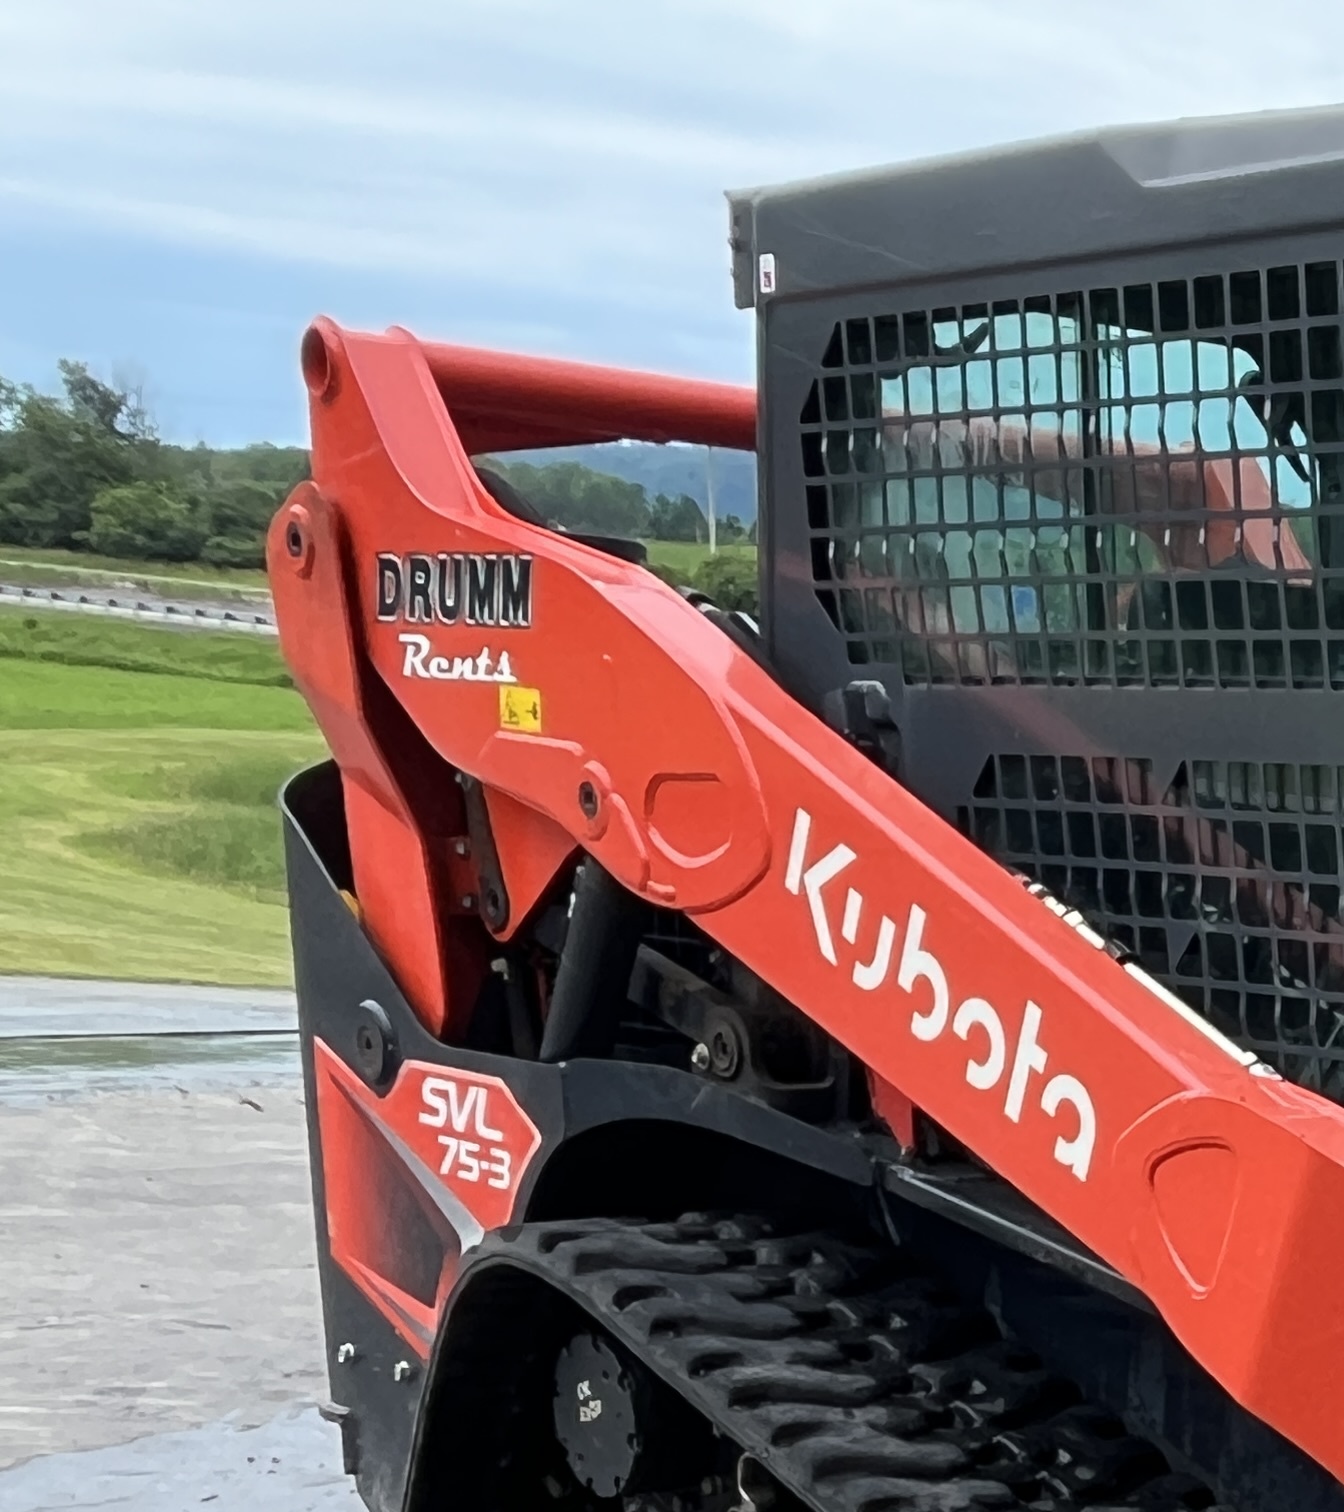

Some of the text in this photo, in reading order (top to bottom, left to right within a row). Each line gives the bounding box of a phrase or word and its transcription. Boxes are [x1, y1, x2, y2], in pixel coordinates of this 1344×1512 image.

[376, 552, 534, 629] DRUMM
[398, 632, 518, 683] Rents
[785, 807, 1097, 1182] Kubota
[418, 1077, 504, 1142] SVL
[437, 1135, 511, 1190] 75-3
